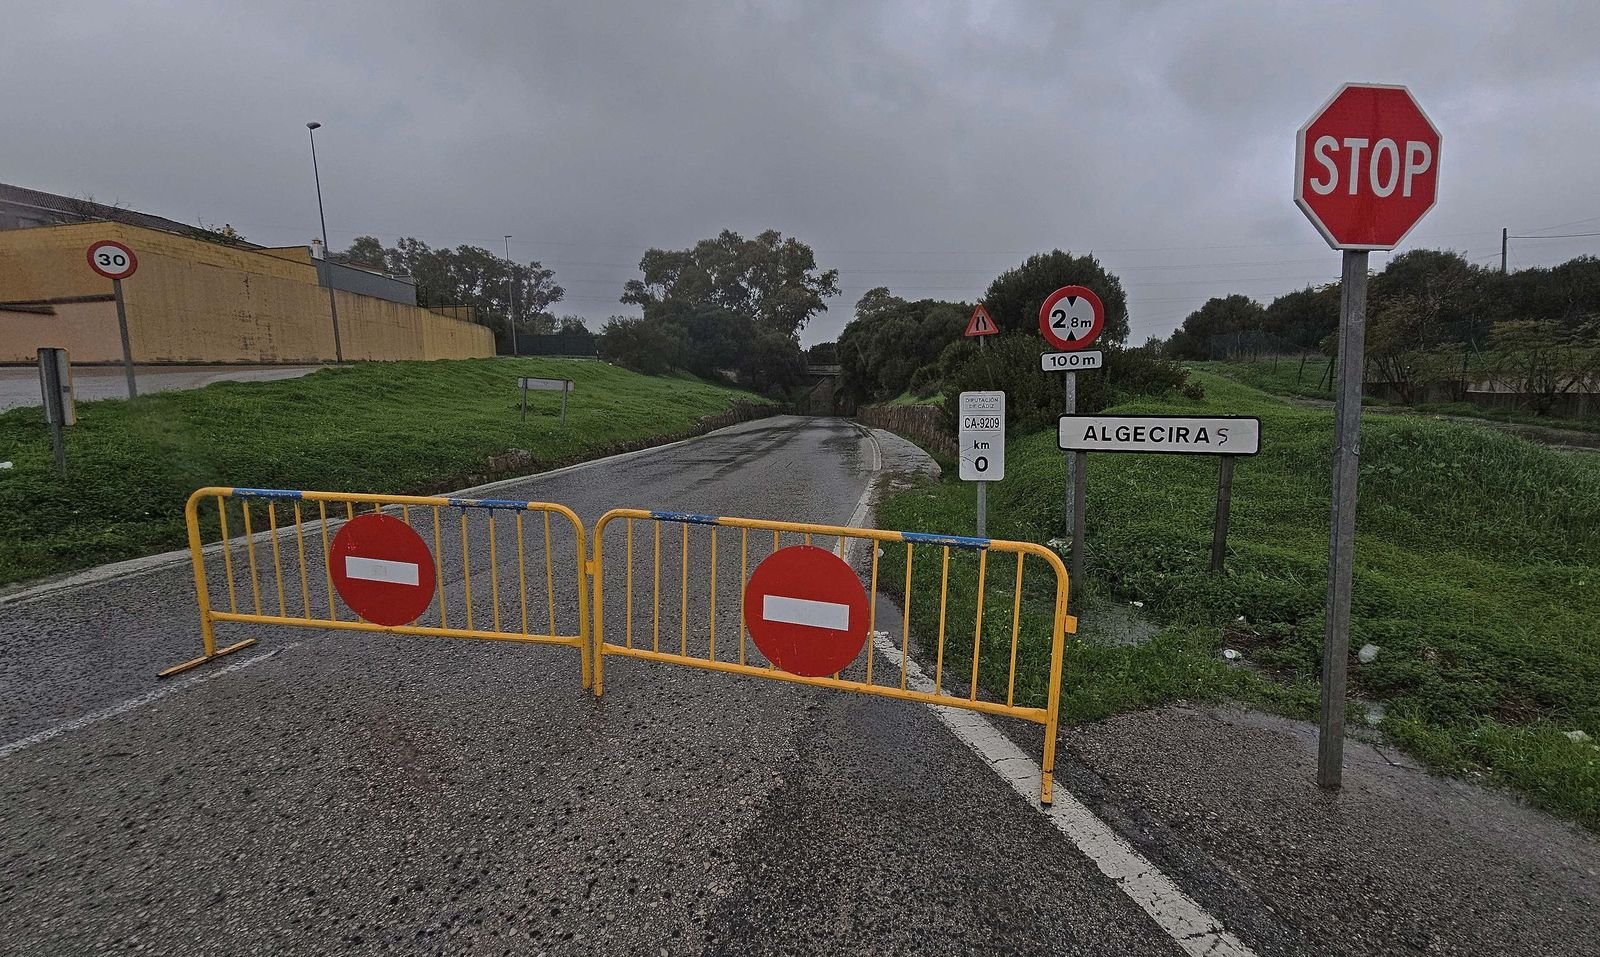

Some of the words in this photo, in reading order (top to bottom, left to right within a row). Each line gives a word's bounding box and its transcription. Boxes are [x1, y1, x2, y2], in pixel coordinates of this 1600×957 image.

[1309, 135, 1432, 198] STOP
[98, 253, 126, 267] 30
[964, 417, 1000, 429] CA-9209
[1083, 425, 1230, 447] ALGECIRAS
[973, 440, 990, 450] km
[975, 456, 989, 472] 0
